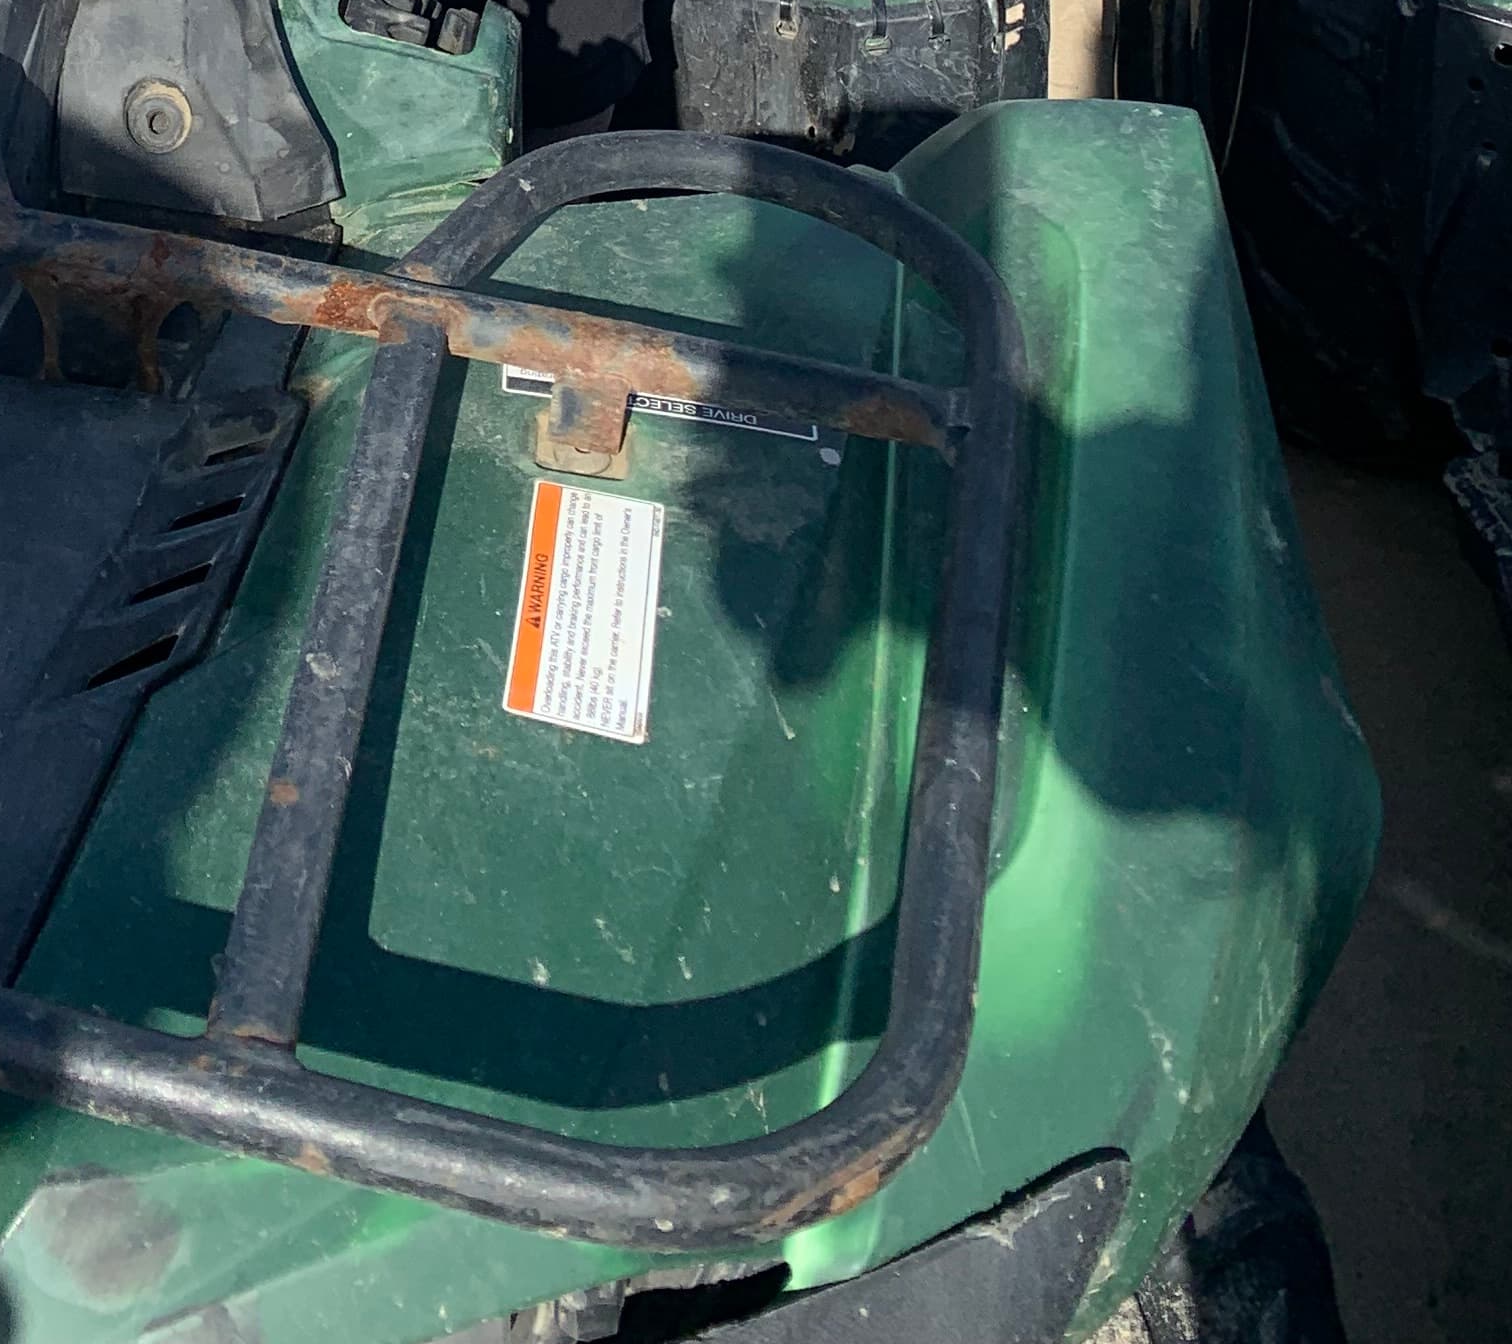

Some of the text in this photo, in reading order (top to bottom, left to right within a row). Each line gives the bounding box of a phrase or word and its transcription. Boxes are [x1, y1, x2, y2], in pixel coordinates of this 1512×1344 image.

[703, 407, 758, 426] DRIVE
[528, 553, 549, 613] WARNING
[540, 664, 558, 713] Overloading
[549, 630, 561, 647] ATV
[599, 697, 613, 728] NEVER
